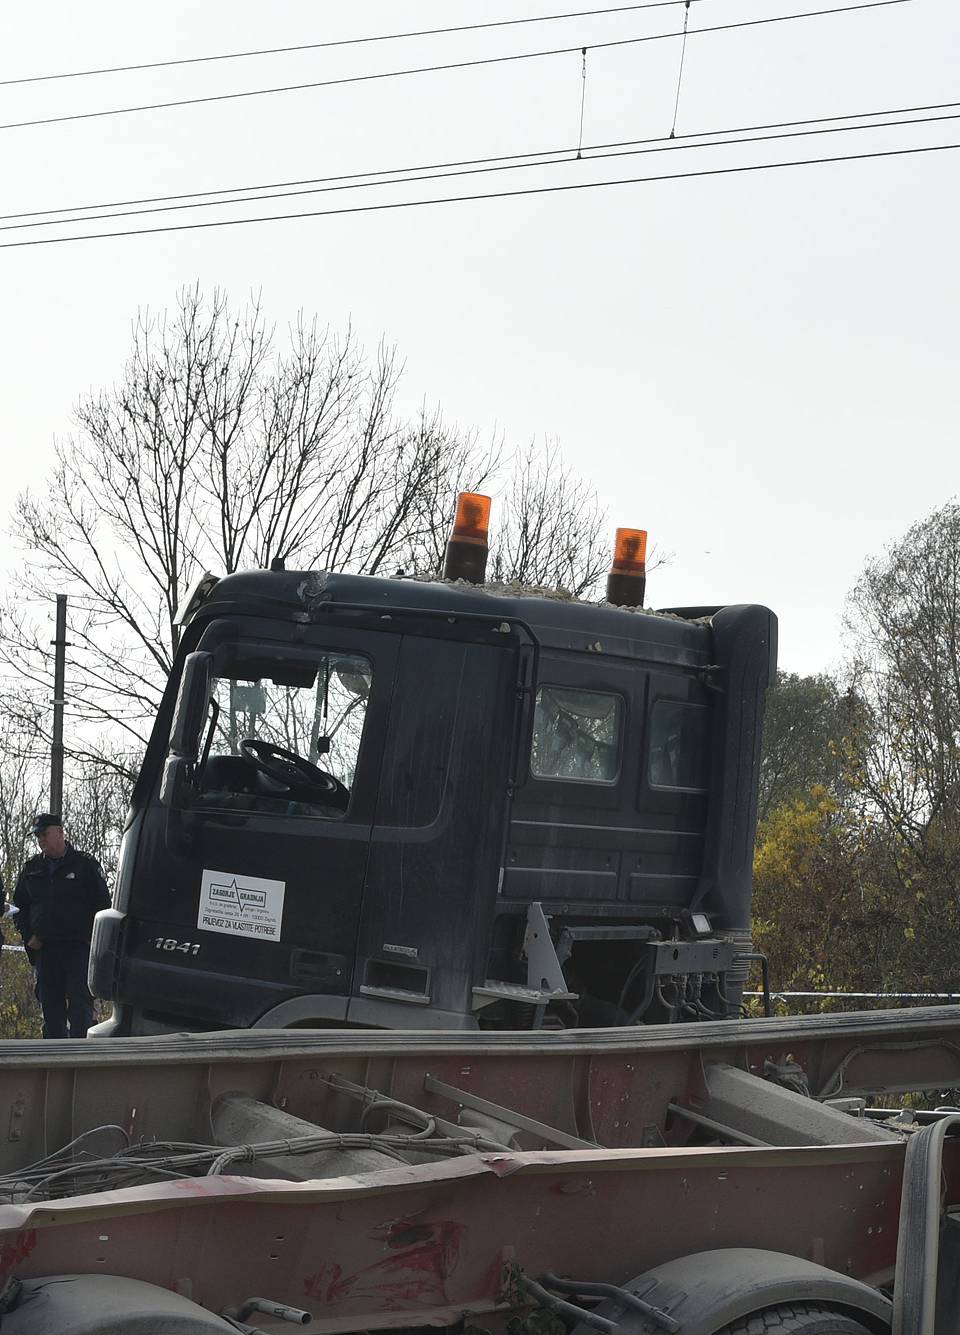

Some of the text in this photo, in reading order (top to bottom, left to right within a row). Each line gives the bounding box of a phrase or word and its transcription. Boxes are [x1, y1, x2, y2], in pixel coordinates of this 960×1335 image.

[225, 919, 232, 929] ZA
[254, 925, 276, 935] POTREBE
[155, 937, 200, 954] 1841
